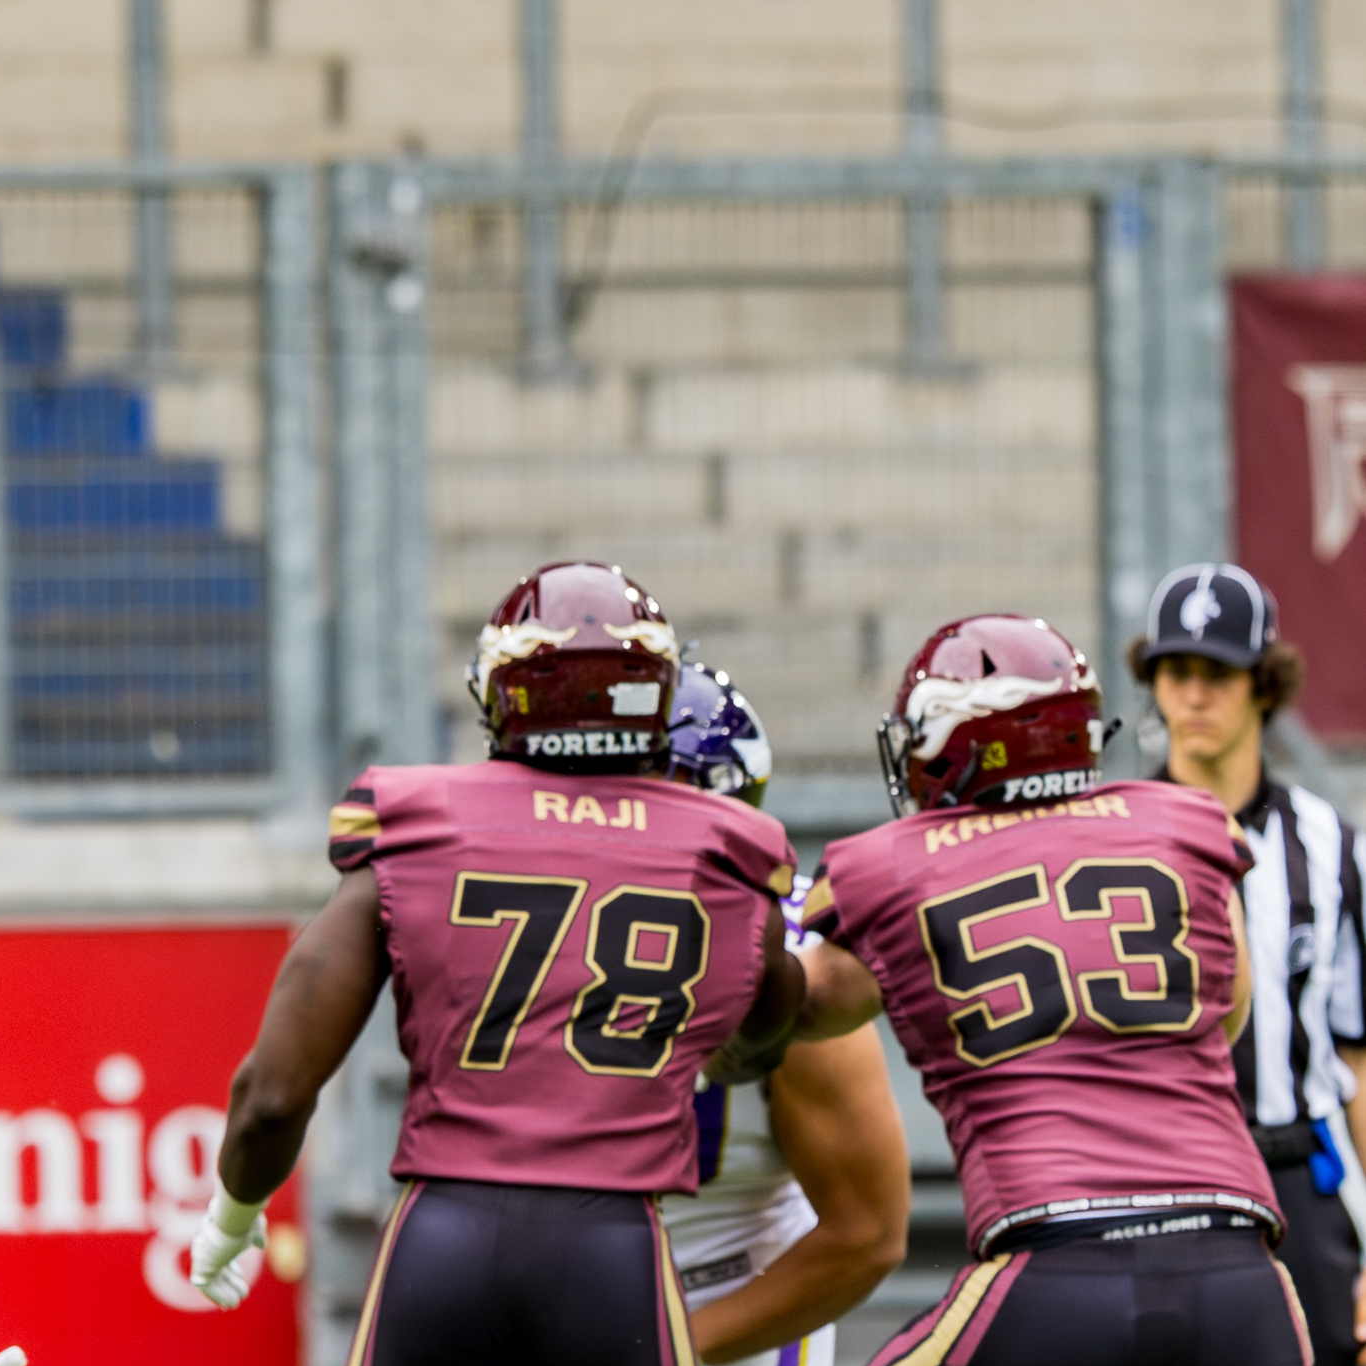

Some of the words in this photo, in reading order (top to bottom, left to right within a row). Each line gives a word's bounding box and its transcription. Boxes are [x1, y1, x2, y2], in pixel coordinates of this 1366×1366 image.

[524, 731, 654, 756] FORELLE
[532, 790, 648, 832] RAJI
[1002, 769, 1103, 804] FORELL
[923, 793, 1133, 855] KREER
[449, 870, 712, 1079] 78
[917, 861, 1204, 1068] 53
